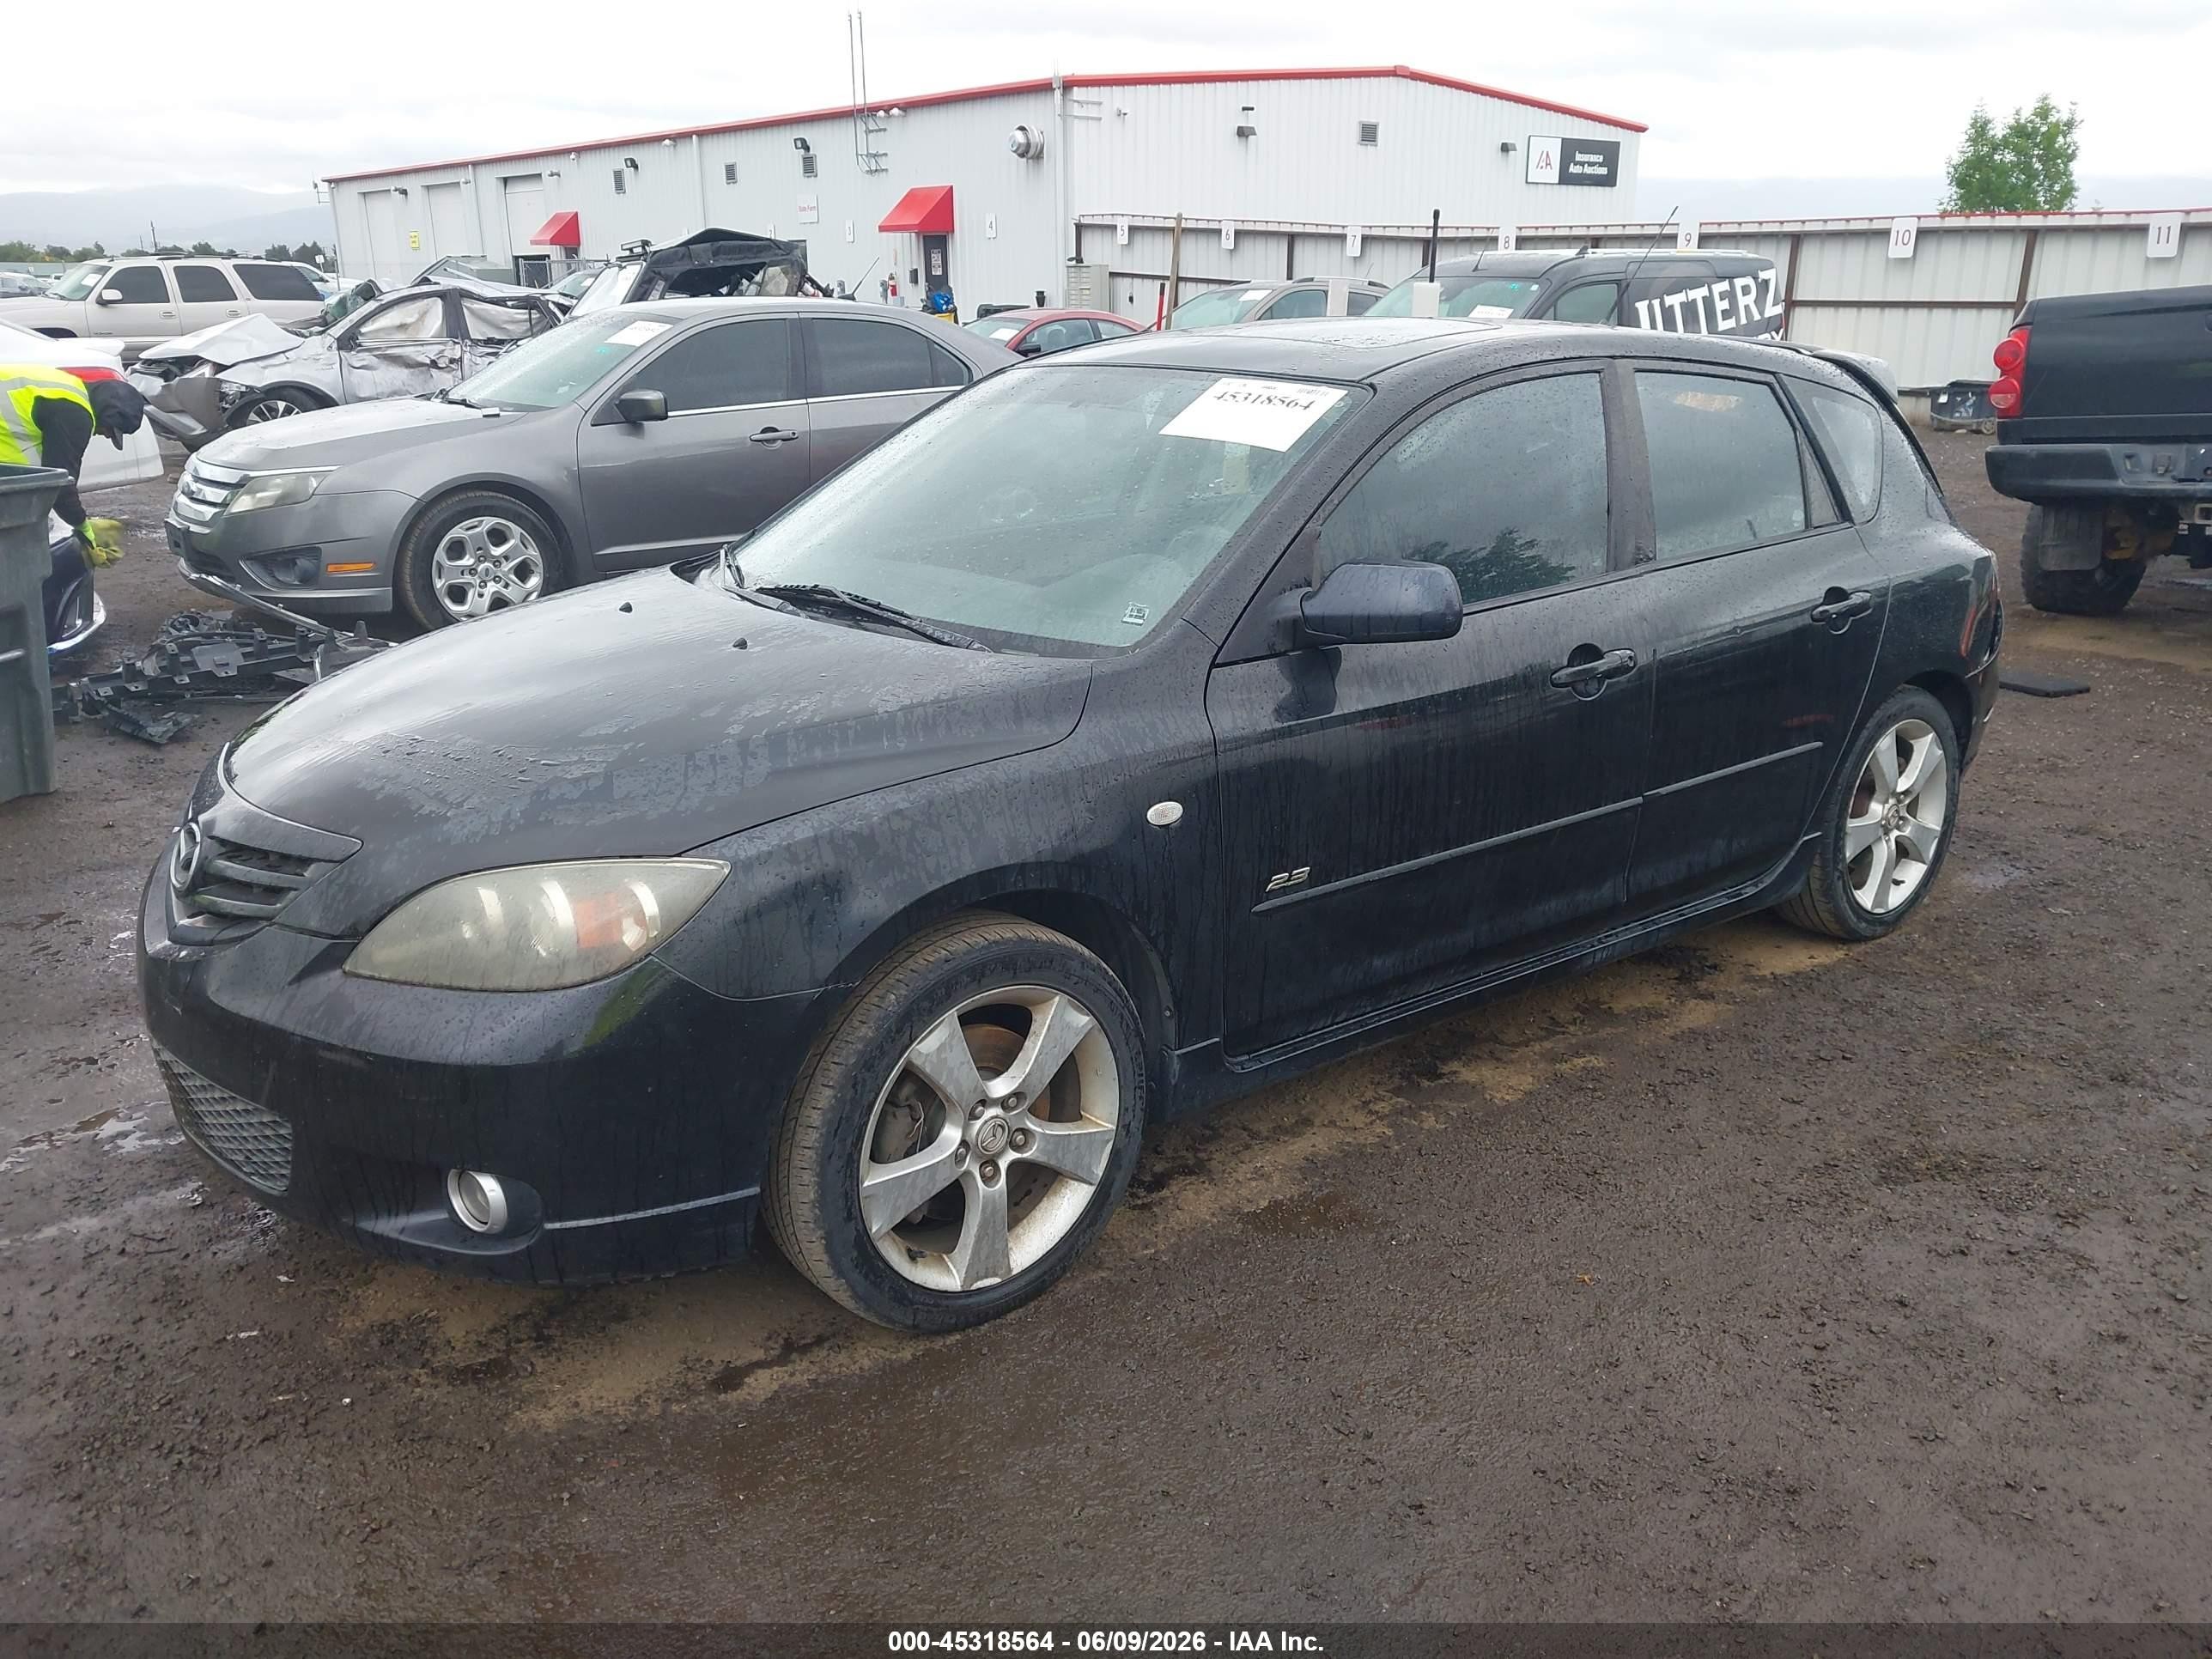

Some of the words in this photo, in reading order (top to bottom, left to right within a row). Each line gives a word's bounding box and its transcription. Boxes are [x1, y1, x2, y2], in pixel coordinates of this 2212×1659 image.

[1575, 150, 1603, 162] Insurance
[1568, 162, 1583, 173] Auto
[1583, 163, 1608, 175] Auctions
[1120, 225, 1125, 237] 5
[1224, 228, 1231, 241] 6
[1894, 228, 1911, 246] 10
[2156, 225, 2172, 245] 11
[1351, 234, 1357, 248] 7
[1504, 235, 1510, 250] 8
[1685, 232, 1692, 247] 9
[1212, 391, 1316, 410] 45318564
